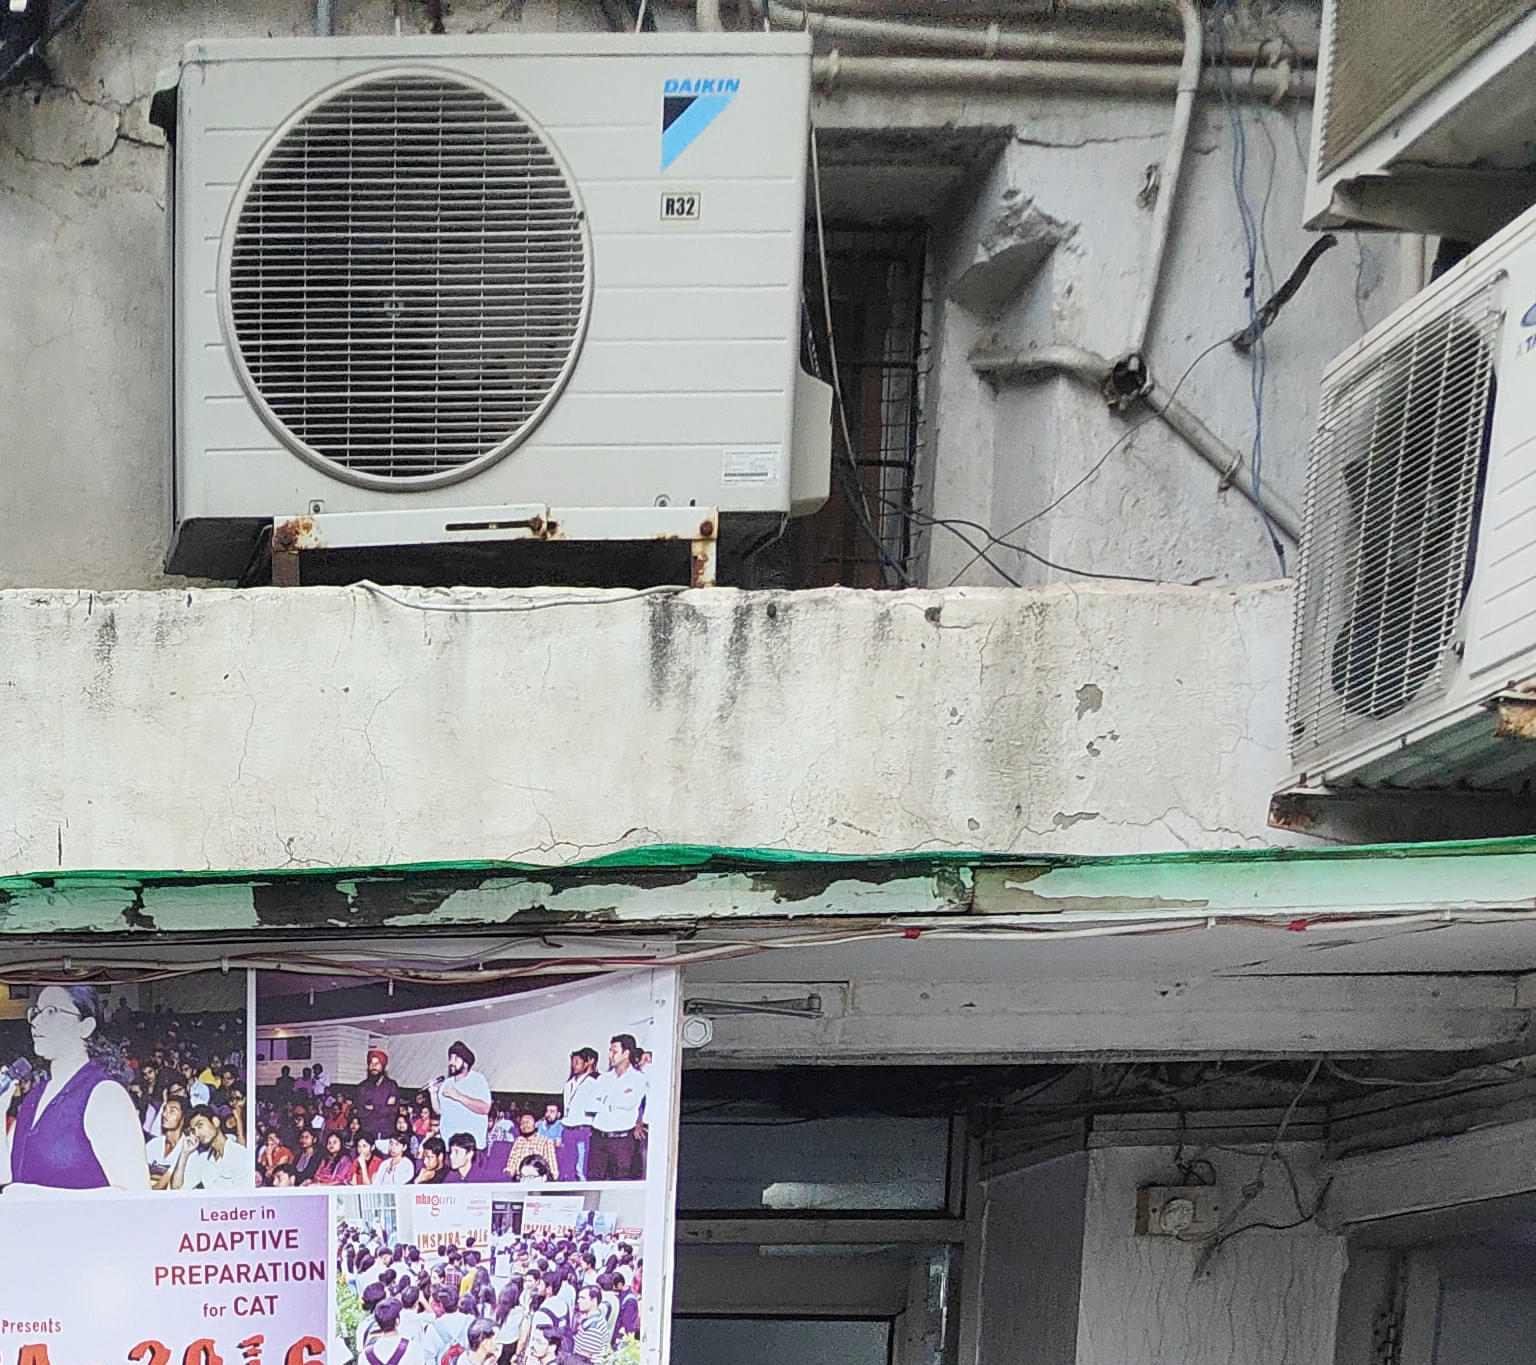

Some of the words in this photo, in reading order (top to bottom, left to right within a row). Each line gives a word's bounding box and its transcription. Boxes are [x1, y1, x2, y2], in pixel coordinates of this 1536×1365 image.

[664, 79, 741, 93] DAIKIN
[665, 197, 696, 216] R32
[200, 1207, 257, 1222] Leader
[261, 1205, 276, 1220] in
[178, 1228, 299, 1253] ADAPTIVE
[154, 1260, 326, 1287] PREPARATION
[203, 1302, 227, 1318] for
[233, 1294, 279, 1317] CAT
[1, 1317, 62, 1334] Presents
